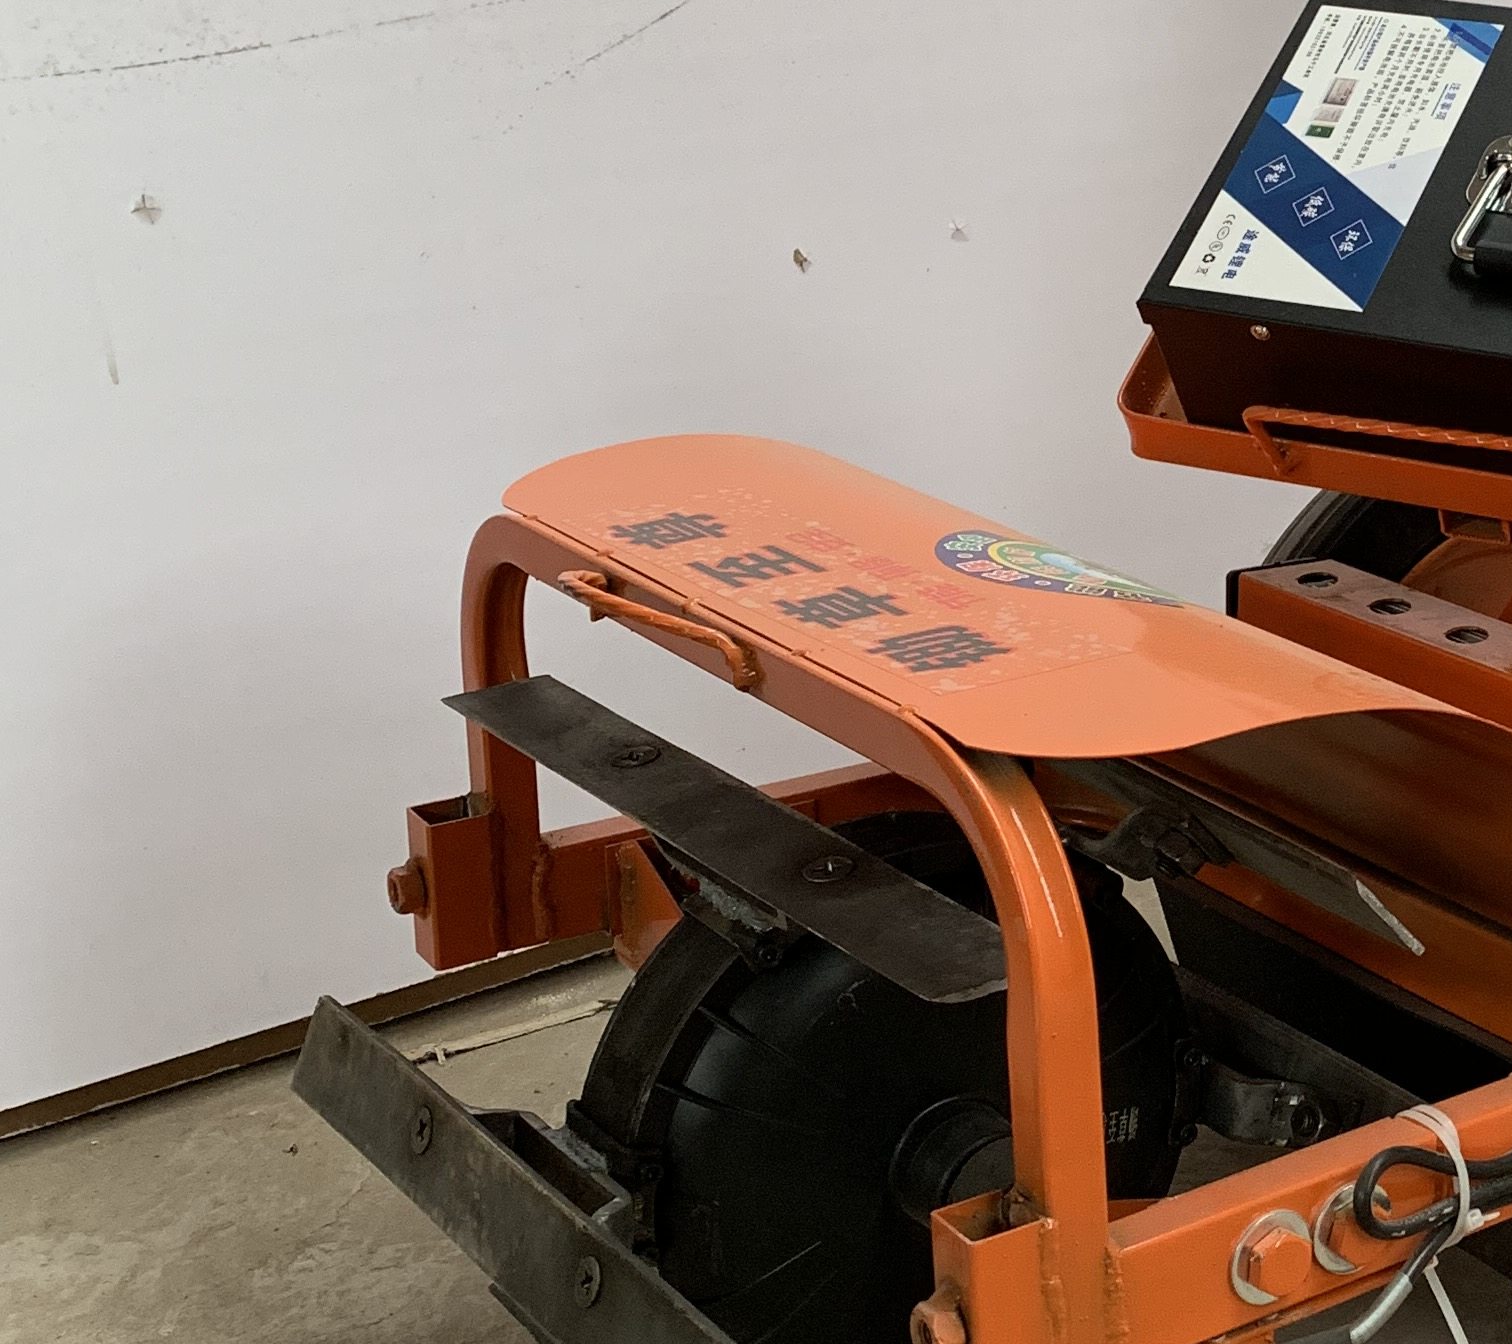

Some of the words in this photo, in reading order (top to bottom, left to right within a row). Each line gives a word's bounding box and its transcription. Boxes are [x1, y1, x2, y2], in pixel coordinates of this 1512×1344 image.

[1435, 82, 1462, 122] 注意事项
[1261, 160, 1288, 184] 节能
[1297, 194, 1327, 219] 低碳
[1220, 228, 1253, 280] 途威锂电
[1335, 229, 1362, 253] 环保
[607, 510, 1016, 673] 锄草至尊
